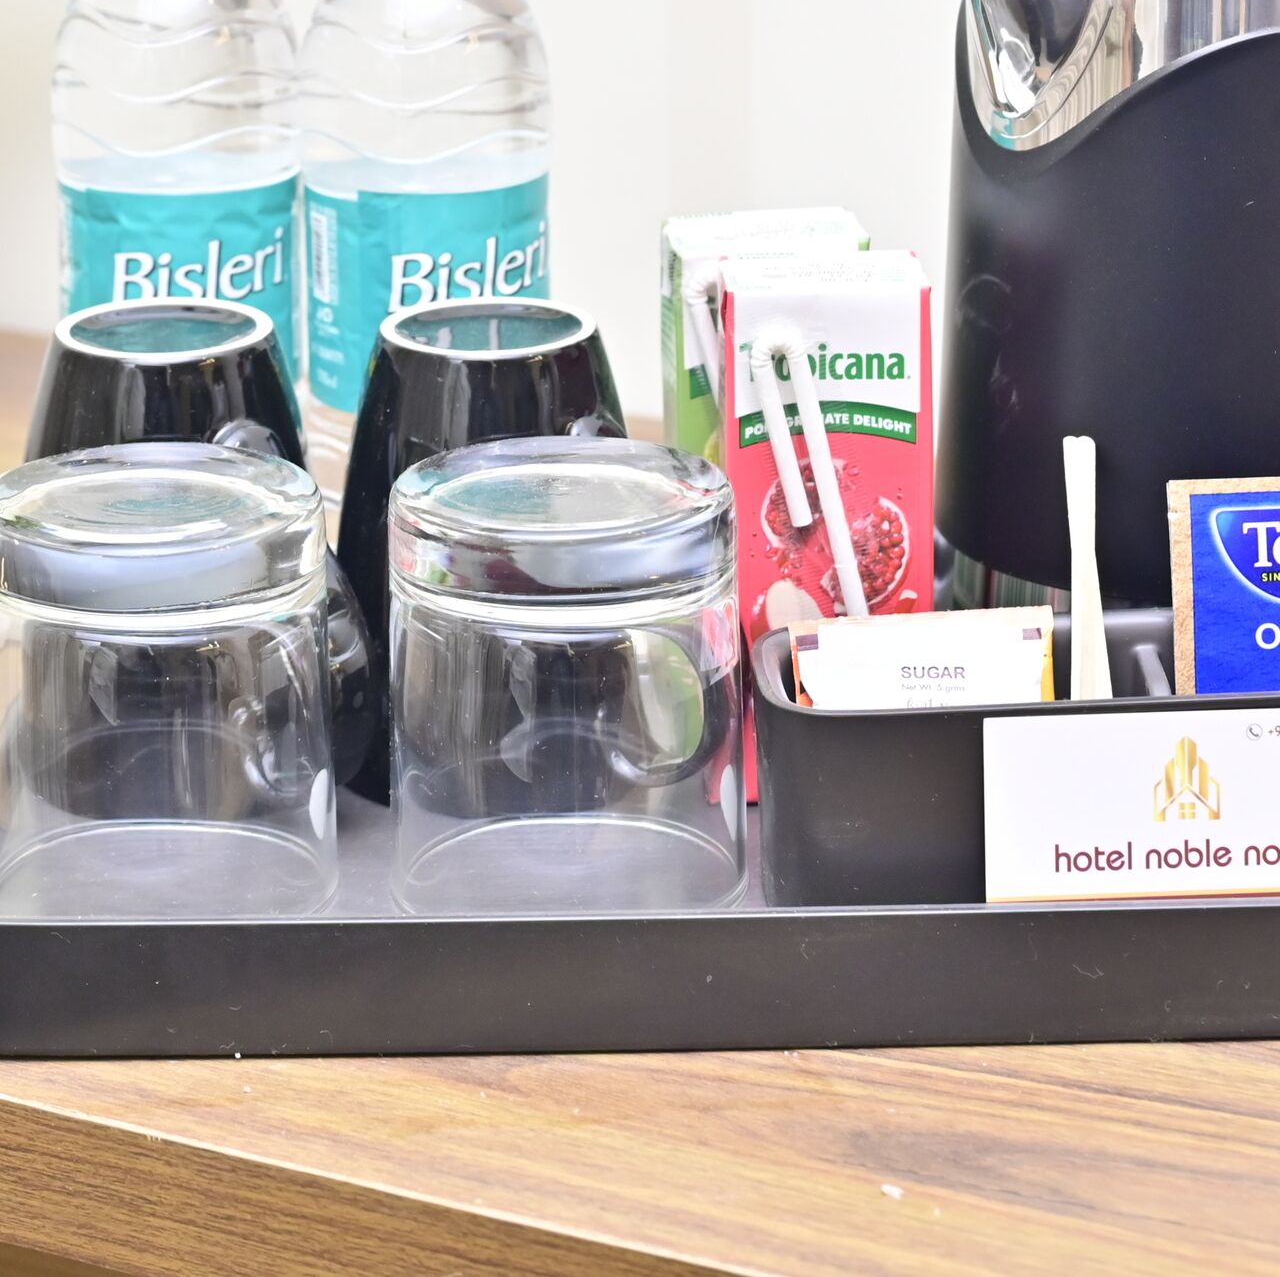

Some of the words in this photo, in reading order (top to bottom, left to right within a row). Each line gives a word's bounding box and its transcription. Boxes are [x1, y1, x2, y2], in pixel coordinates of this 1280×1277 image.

[113, 227, 284, 302] Bisleri
[389, 221, 546, 313] Bisleri
[853, 413, 913, 435] DELIGHT
[900, 665, 966, 680] SUGAR
[1054, 841, 1133, 873] hotel
[1145, 839, 1232, 870] noble
